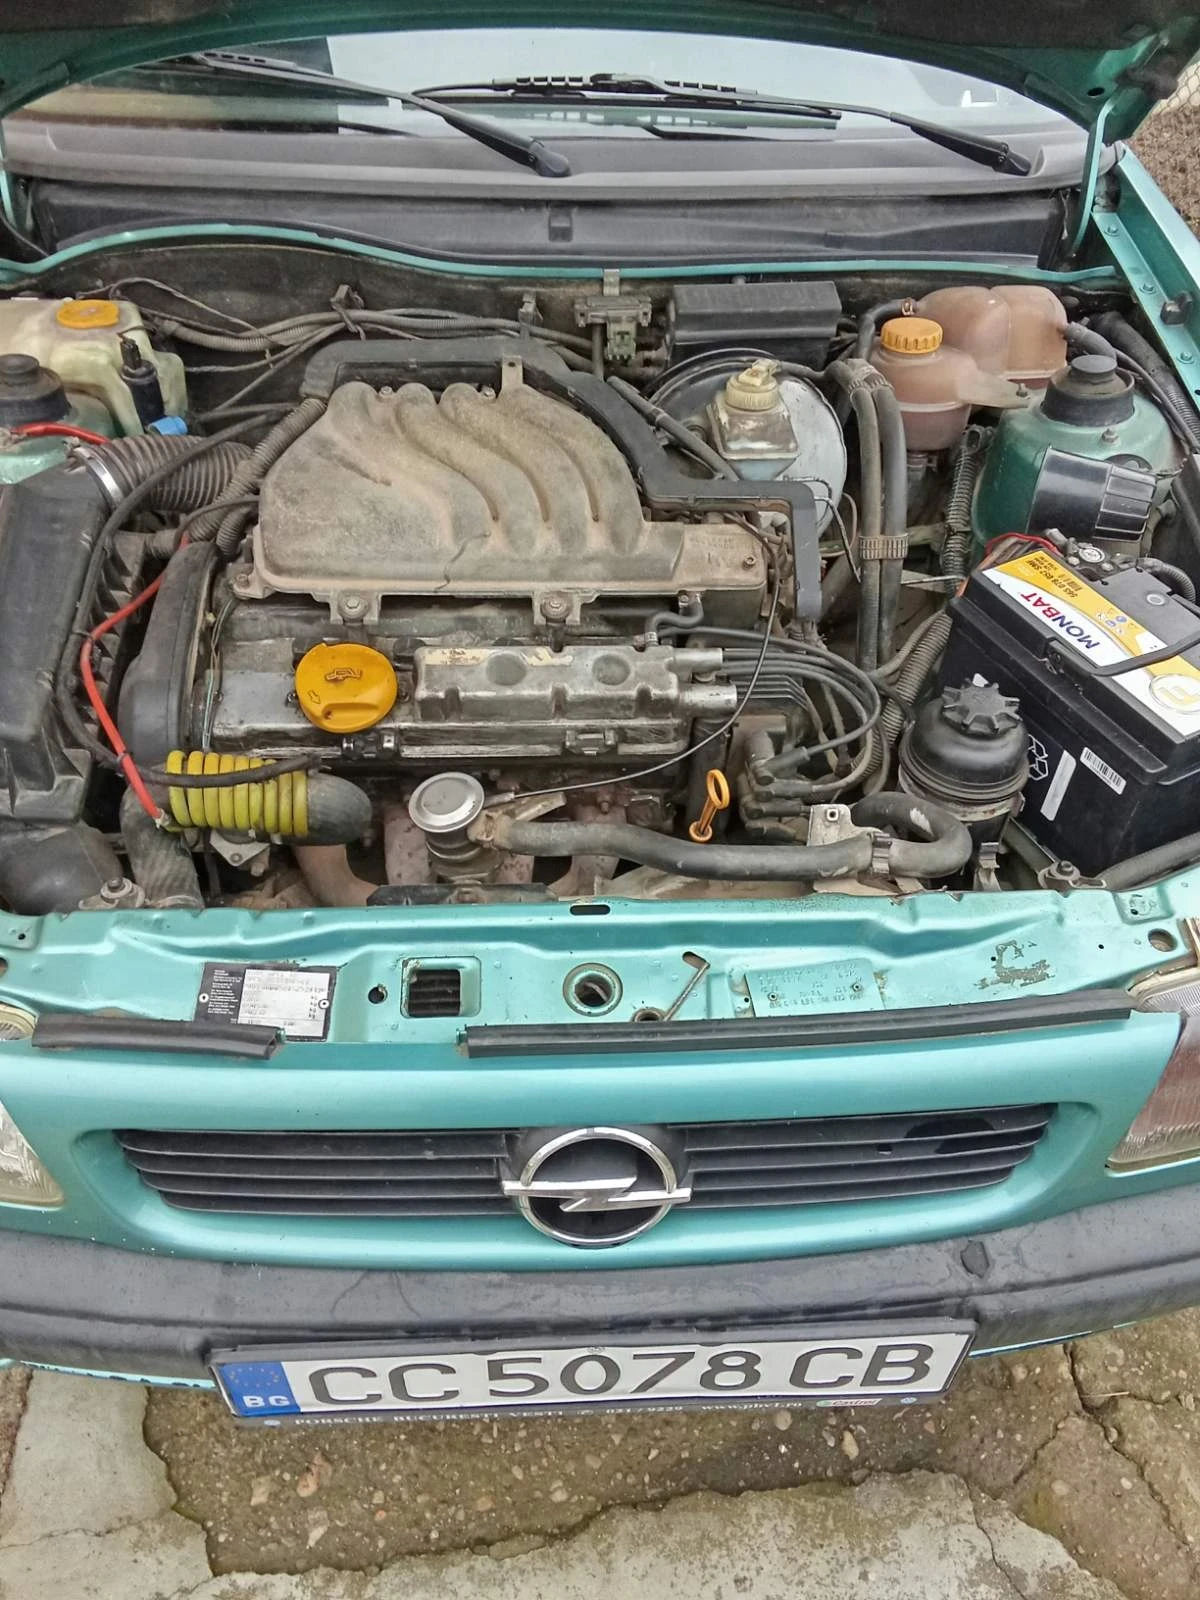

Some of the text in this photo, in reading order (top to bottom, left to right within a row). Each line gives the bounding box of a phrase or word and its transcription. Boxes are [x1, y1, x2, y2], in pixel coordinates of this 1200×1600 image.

[1020, 591, 1100, 650] MONBAT
[308, 1343, 934, 1405] CC 5078 CB
[244, 1396, 291, 1407] BG
[295, 1417, 383, 1425] PORSCHE
